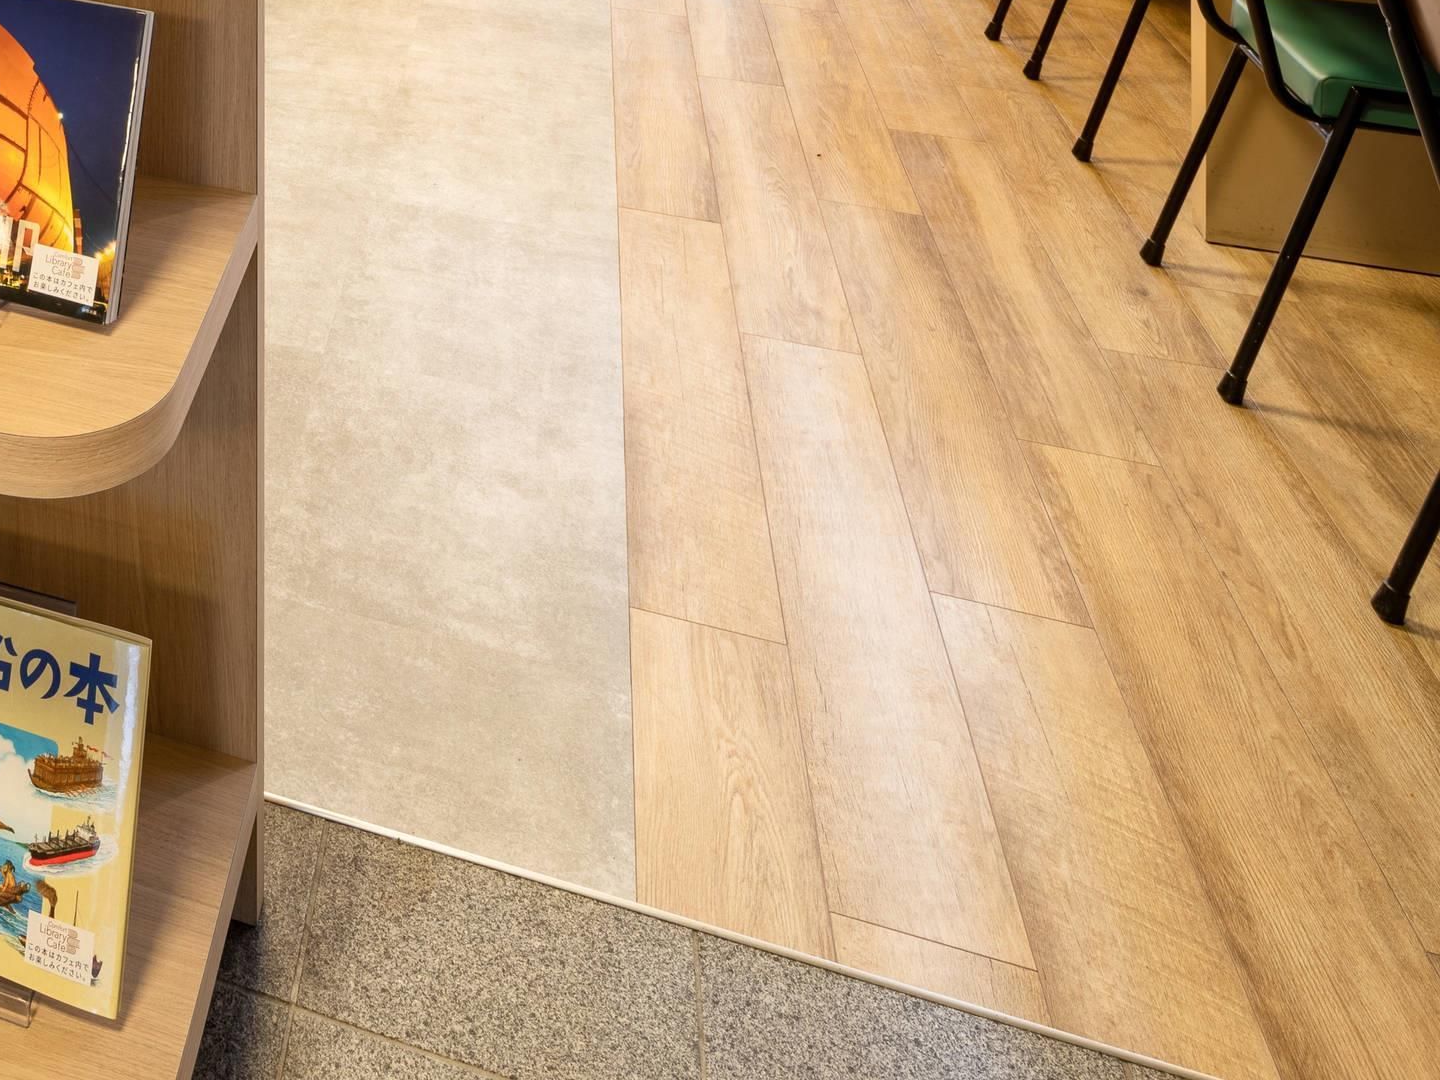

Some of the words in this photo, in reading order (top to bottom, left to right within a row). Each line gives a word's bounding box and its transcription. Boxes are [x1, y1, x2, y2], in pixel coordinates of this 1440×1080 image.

[45, 254, 72, 271] Library
[51, 265, 71, 278] Cafe
[33, 272, 93, 294] この本はカフェ内で
[40, 923, 67, 944] Library
[46, 937, 66, 953] Cafe
[28, 943, 89, 972] この本はカフェ内で
[29, 953, 86, 982] お楽しみください。
